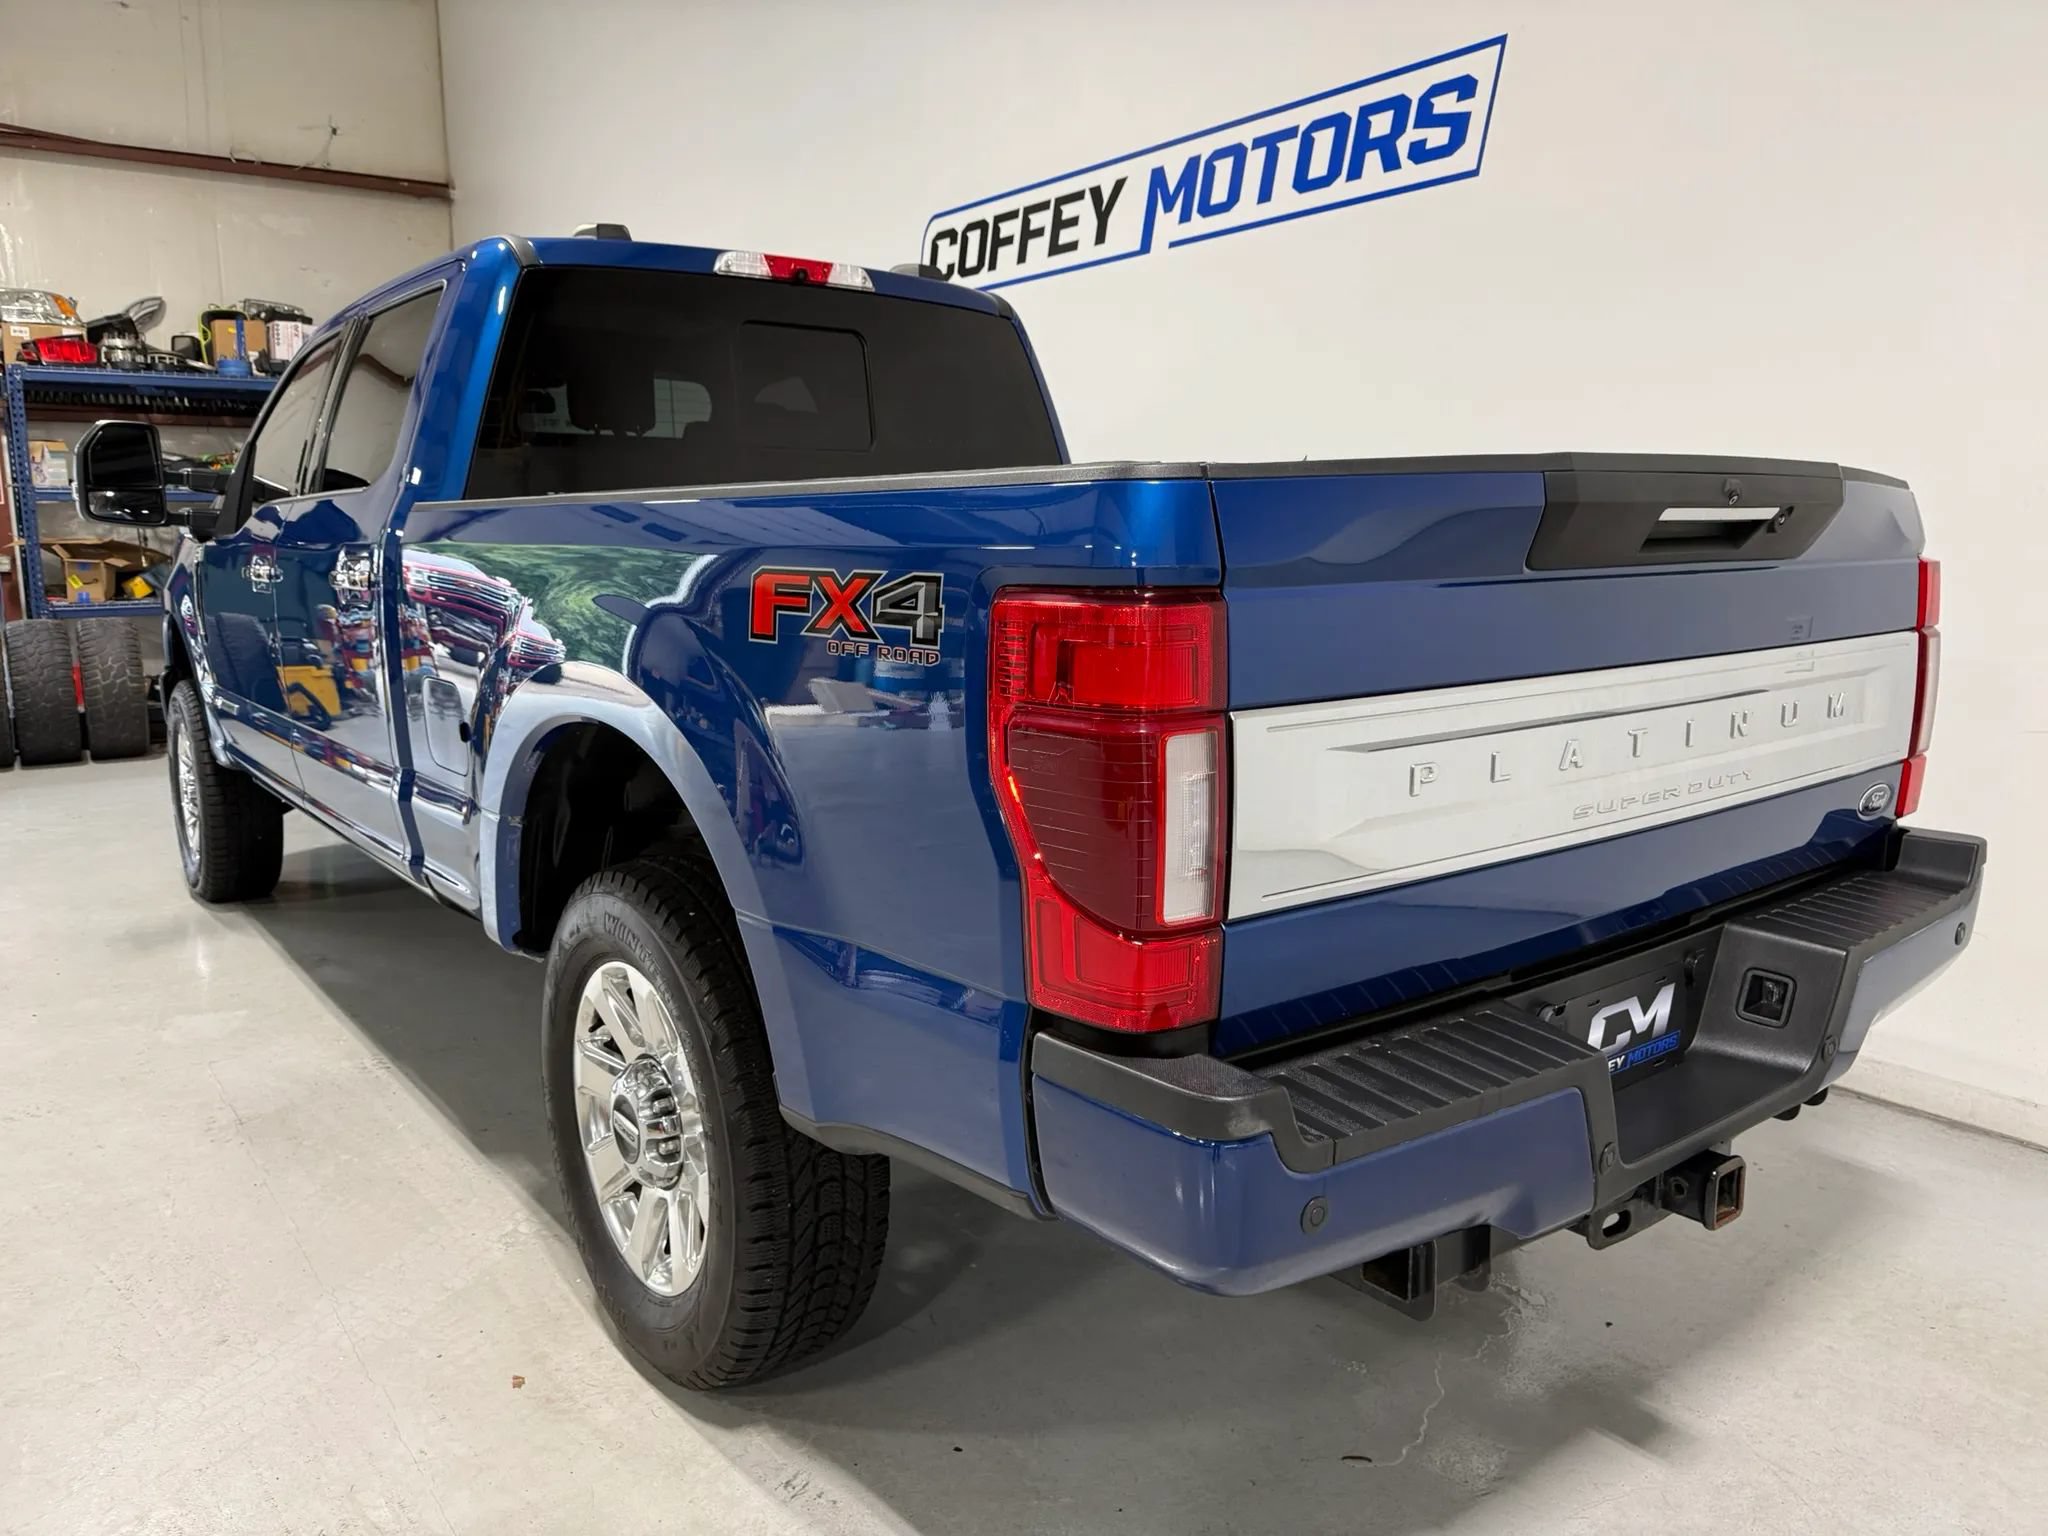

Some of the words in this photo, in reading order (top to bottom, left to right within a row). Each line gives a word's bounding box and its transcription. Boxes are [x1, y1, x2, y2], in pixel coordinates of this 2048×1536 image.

[930, 175, 1128, 283] COFFEY
[1141, 73, 1479, 254] MOTORS
[748, 565, 945, 649] FX4
[826, 639, 869, 658] OFF
[877, 644, 941, 667] ROAD
[1409, 691, 1847, 797] PLATINUM
[1572, 785, 1681, 821] SUPER
[1688, 769, 1753, 797] DUTY
[1587, 982, 1676, 1056] CM
[1627, 1033, 1678, 1064] MOTORS
